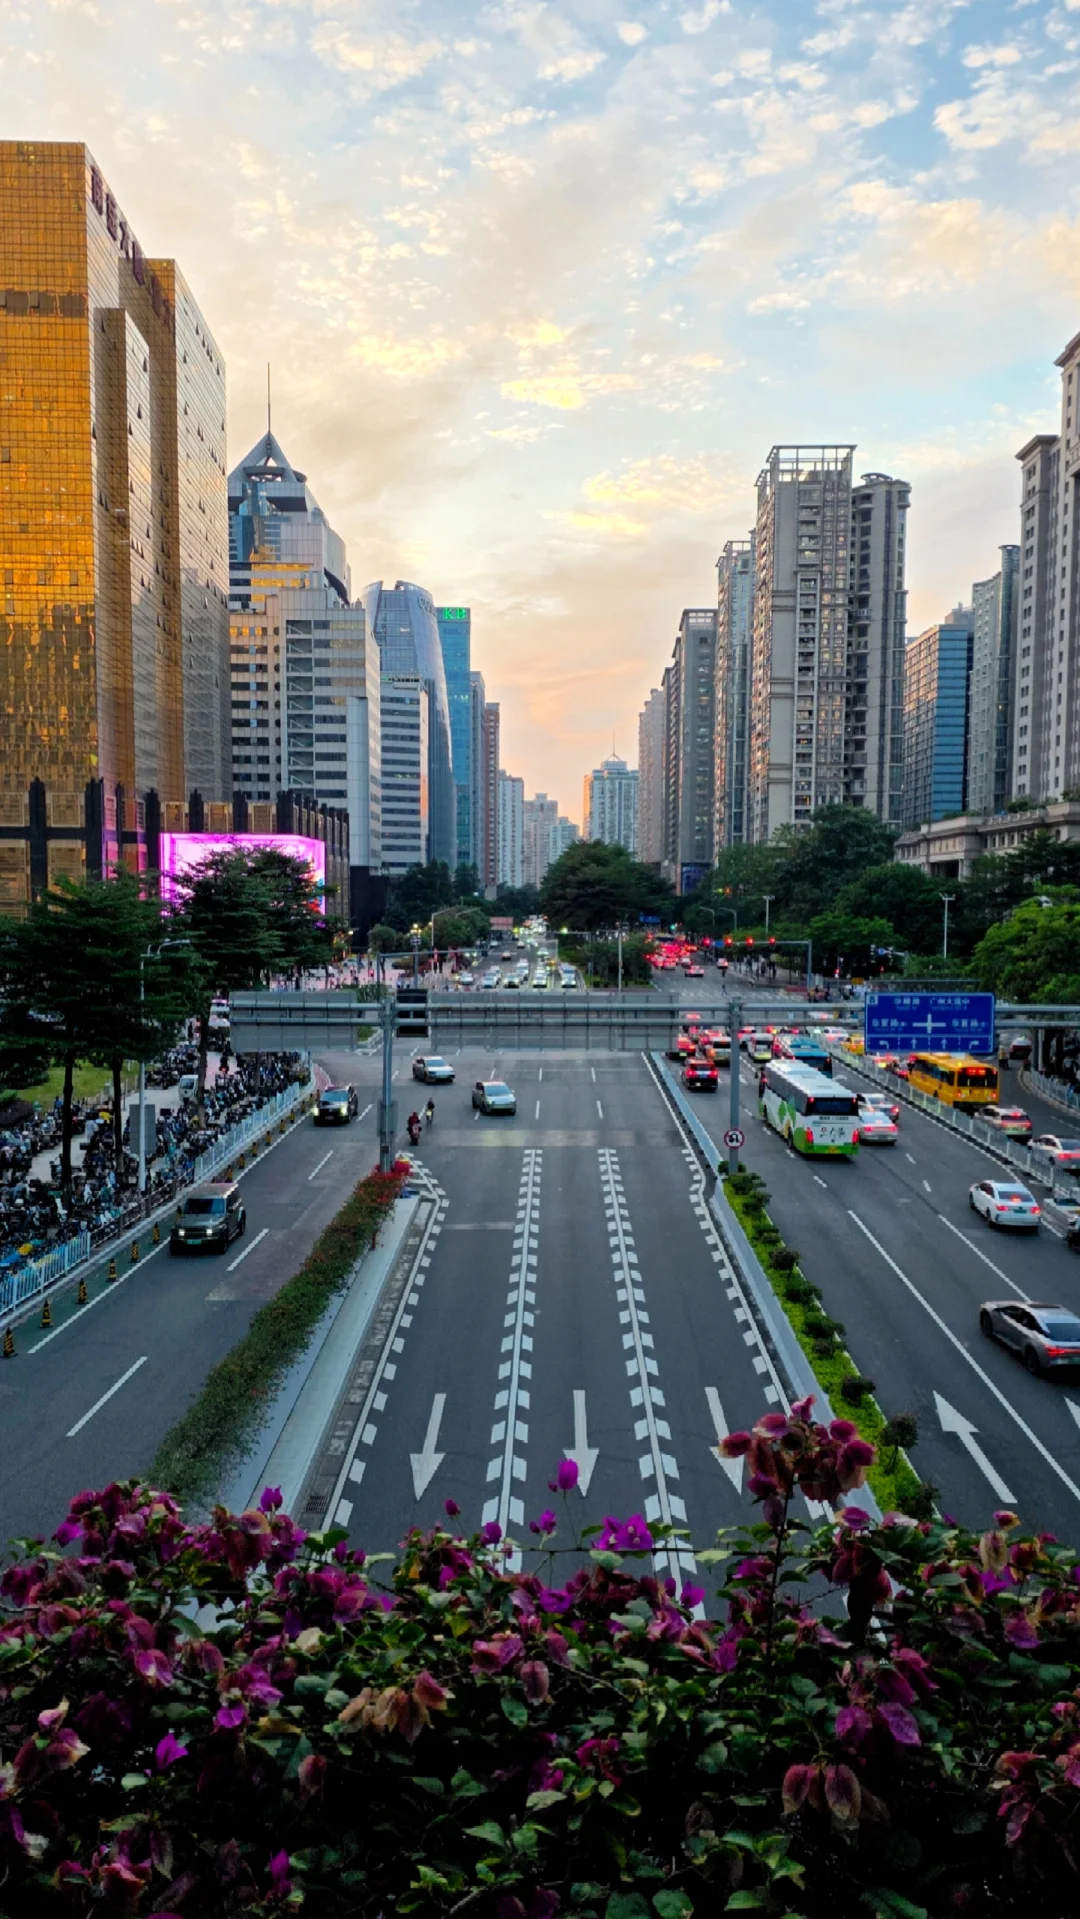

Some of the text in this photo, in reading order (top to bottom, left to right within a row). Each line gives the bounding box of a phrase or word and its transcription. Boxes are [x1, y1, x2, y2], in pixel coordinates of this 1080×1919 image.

[443, 607, 467, 620] KB
[930, 996, 970, 1005] 广州大道中
